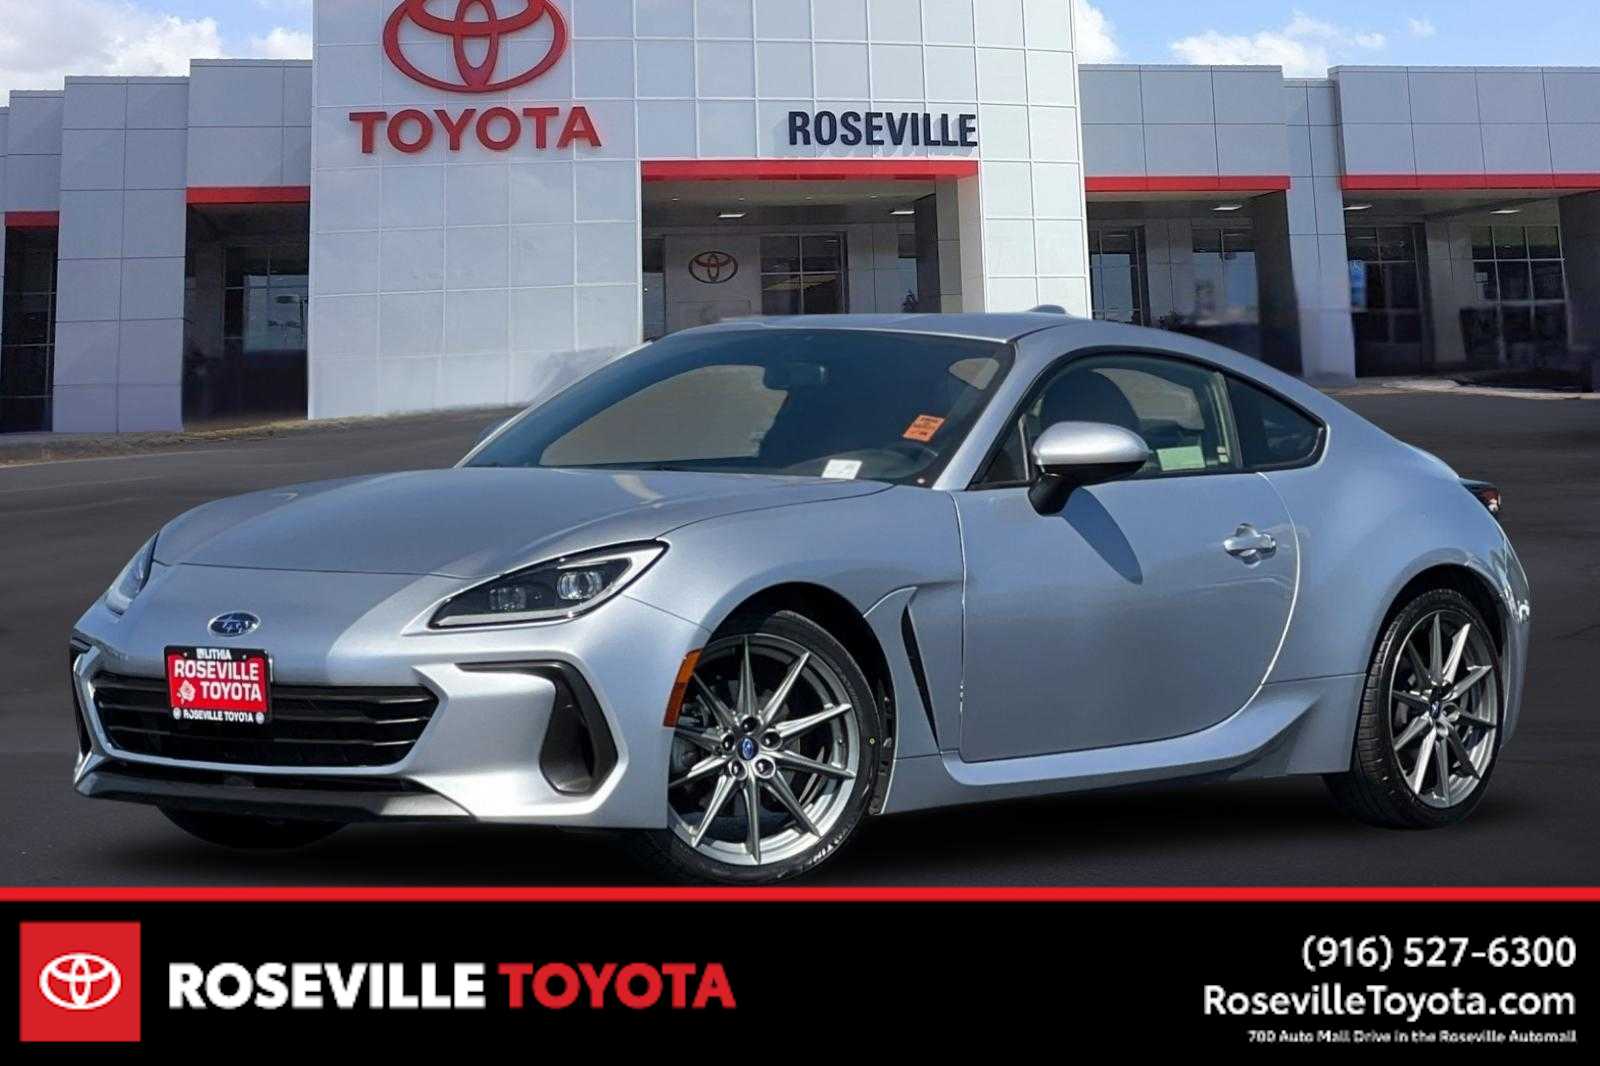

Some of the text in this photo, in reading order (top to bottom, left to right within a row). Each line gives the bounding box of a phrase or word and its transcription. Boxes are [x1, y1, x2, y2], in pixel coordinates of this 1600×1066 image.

[349, 106, 602, 154] TOYOTA
[788, 110, 978, 147] ROSEVILLE
[174, 660, 259, 681] ROSEVILLE
[200, 681, 262, 701] TOYOTA
[183, 708, 254, 722] ROSEVILLE TOYOTA
